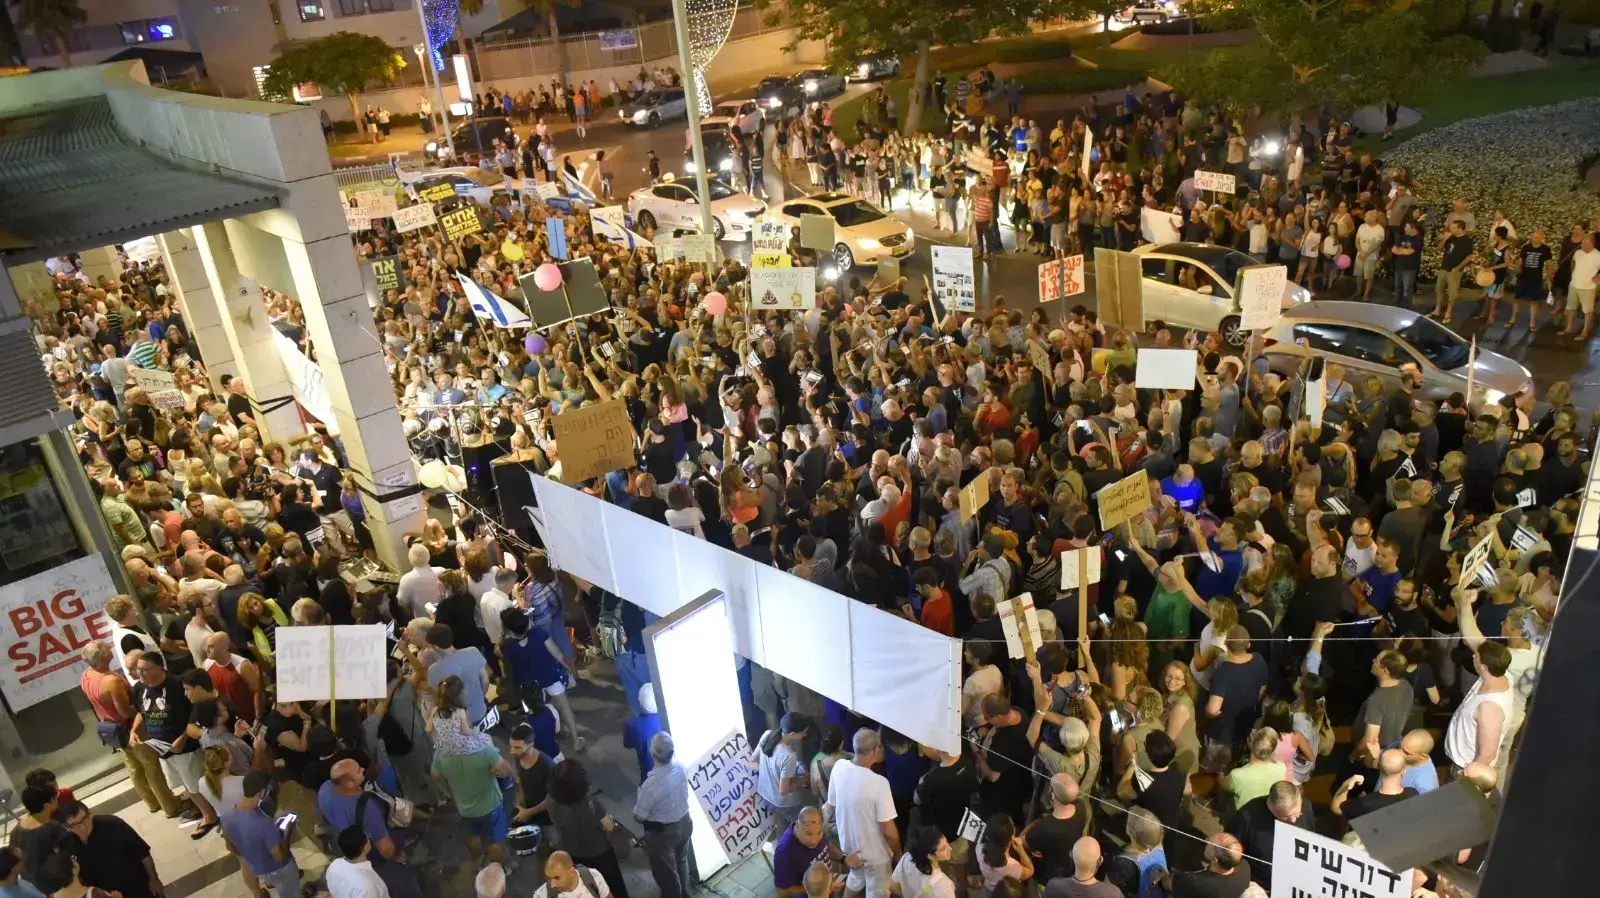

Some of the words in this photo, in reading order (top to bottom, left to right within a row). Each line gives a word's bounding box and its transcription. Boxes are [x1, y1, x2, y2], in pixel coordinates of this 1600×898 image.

[442, 206, 477, 228] אחים
[8, 589, 86, 638] BIG
[8, 610, 114, 672] SALE
[687, 733, 748, 791] מנדלבליט
[716, 791, 763, 840] מקבלים
[1294, 838, 1402, 894] דורשים
